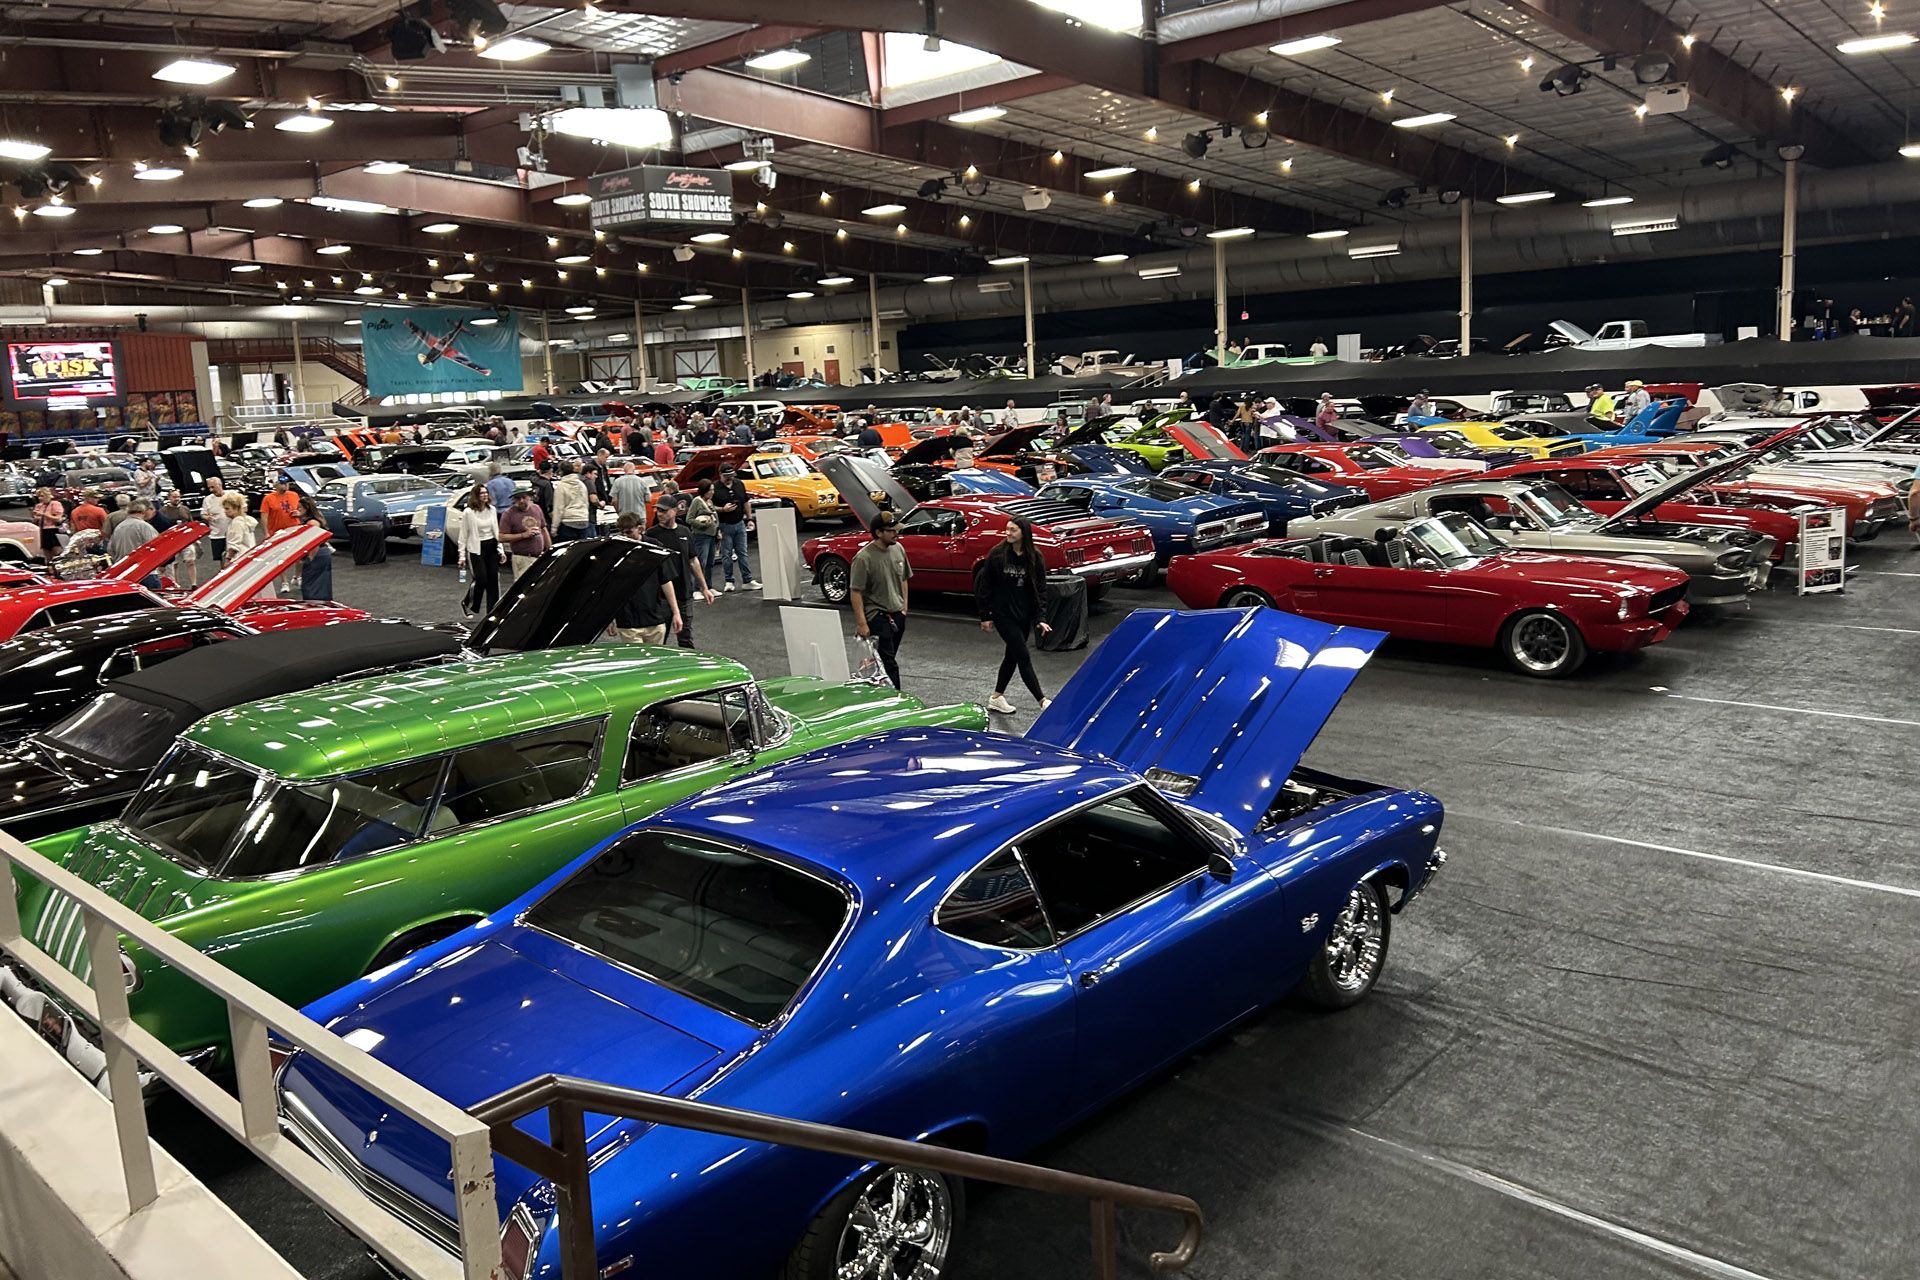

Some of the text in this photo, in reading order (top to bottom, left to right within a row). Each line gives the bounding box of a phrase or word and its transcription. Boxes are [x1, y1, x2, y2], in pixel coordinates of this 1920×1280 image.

[591, 194, 645, 217] SOUTH SHOWCASE
[649, 192, 680, 209] SOUTH
[682, 194, 732, 212] SHOWCASE
[367, 321, 393, 331] Piper
[47, 359, 99, 373] FISK
[1302, 913, 1319, 928] SS
